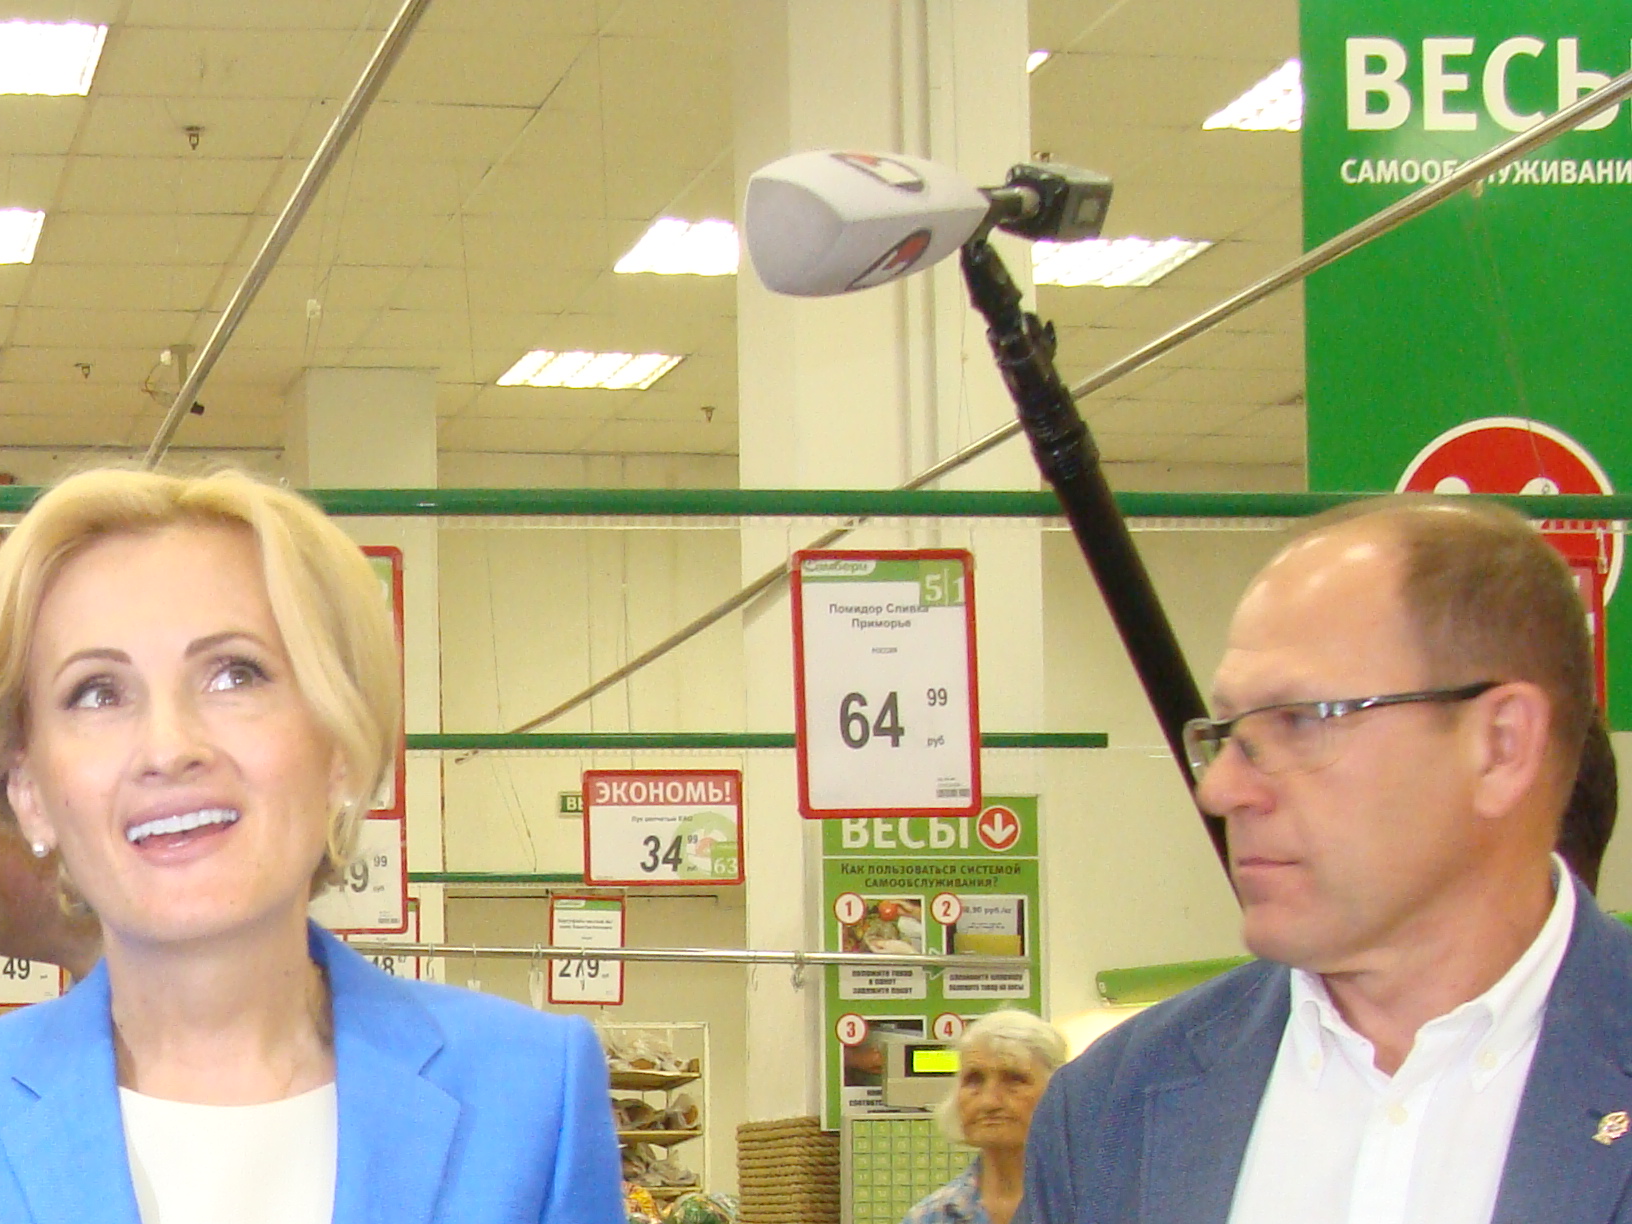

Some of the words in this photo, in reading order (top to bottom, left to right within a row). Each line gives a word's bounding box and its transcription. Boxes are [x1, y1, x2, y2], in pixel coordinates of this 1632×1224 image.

[1340, 158, 1632, 184] САМООУЖИВАНИ
[829, 604, 883, 616] Помидор
[851, 618, 911, 630] Приморье
[926, 687, 948, 707] 99
[839, 691, 905, 749] 64
[927, 735, 945, 748] руб
[595, 781, 732, 804] ЭКОНОМЬ!
[841, 817, 969, 849] ВЕСЫ
[373, 855, 388, 867] 99
[640, 834, 684, 873] 34
[713, 858, 737, 874] 63
[868, 865, 956, 875] ПОЛЬЗОВАТЬСЯ
[960, 863, 1021, 875] СИСТЕМОЙ
[844, 901, 852, 916] 1
[942, 900, 951, 916] 2
[2, 957, 31, 980] 49
[558, 958, 600, 978] 279
[846, 1021, 856, 1038] 3
[943, 1021, 953, 1037] 4
